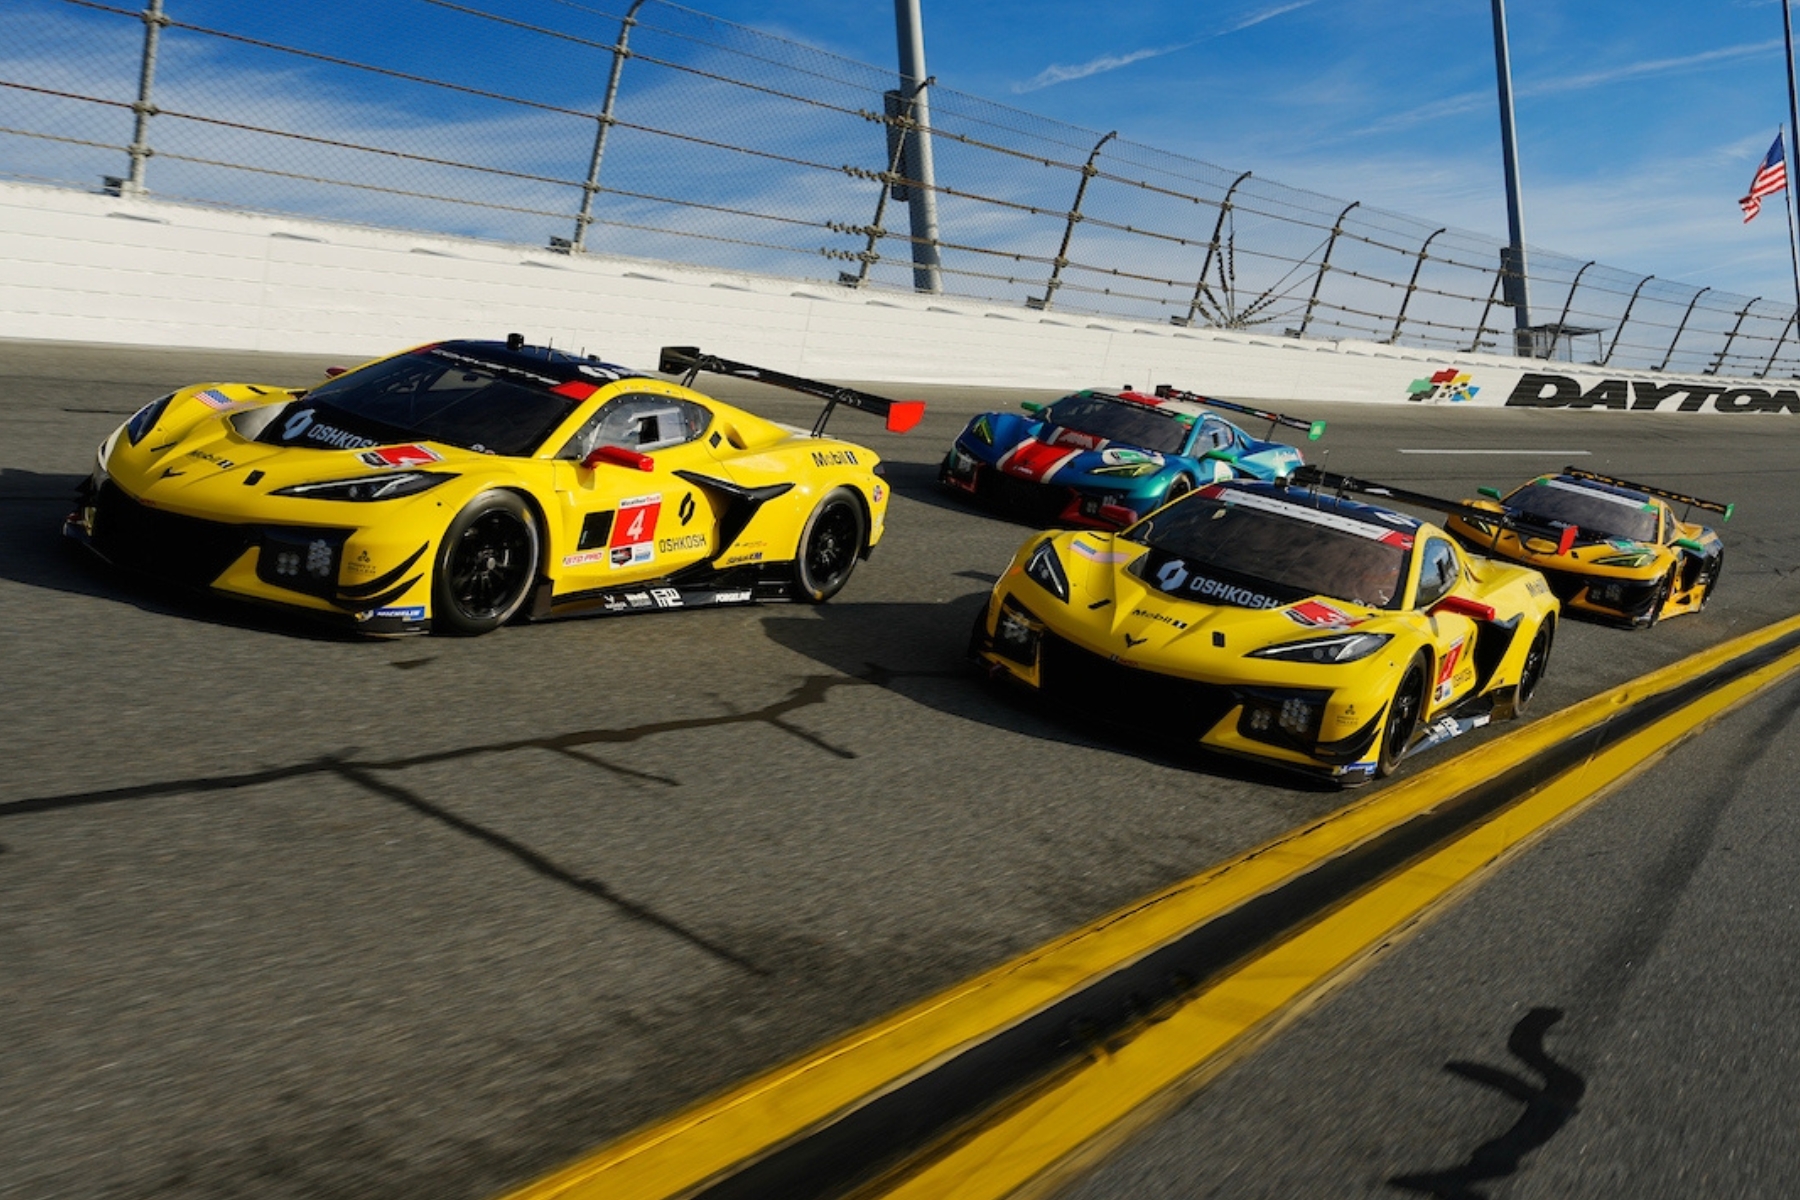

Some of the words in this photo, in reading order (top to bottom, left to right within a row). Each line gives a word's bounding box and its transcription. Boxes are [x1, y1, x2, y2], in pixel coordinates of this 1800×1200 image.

[307, 423, 380, 449] OSHKOS
[626, 508, 646, 542] 4
[658, 533, 707, 554] OSHKOSH
[1190, 576, 1279, 610] OSHKOSH
[1132, 608, 1172, 625] Mobil
